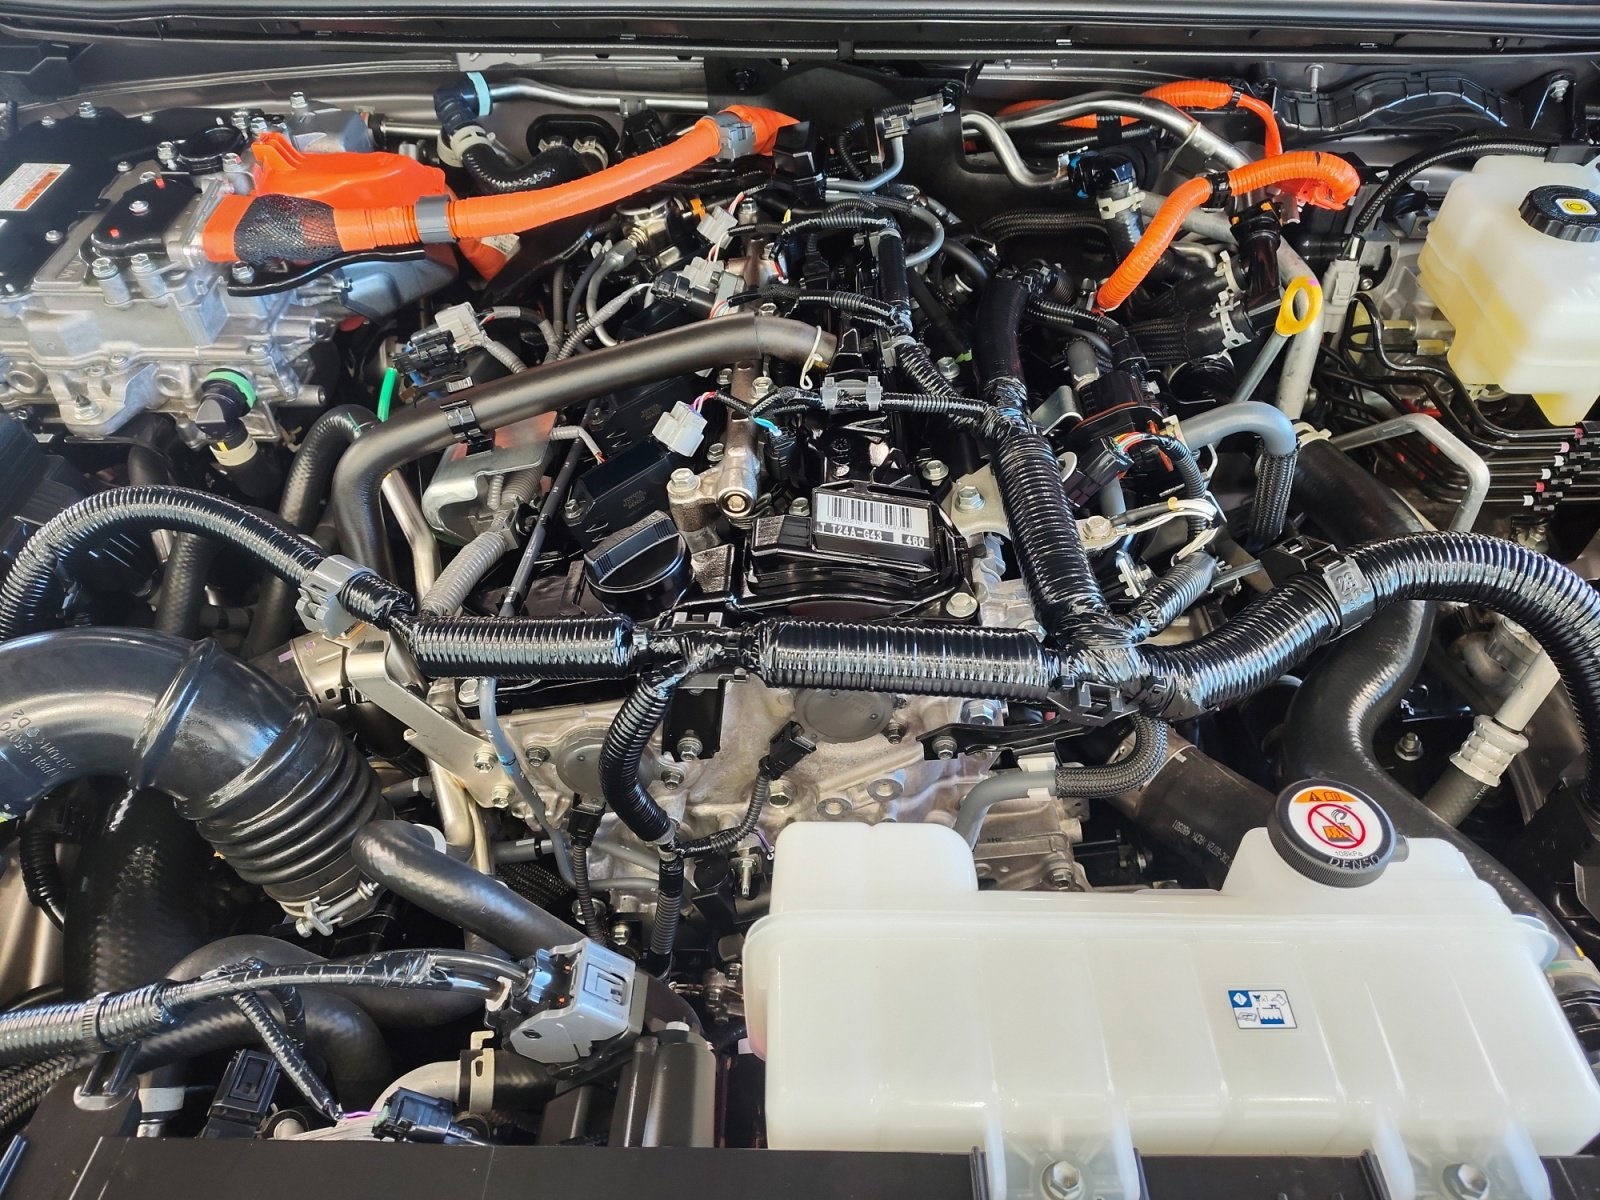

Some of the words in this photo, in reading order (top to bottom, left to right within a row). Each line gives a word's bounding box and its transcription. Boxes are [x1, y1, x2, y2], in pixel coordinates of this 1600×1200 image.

[820, 523, 826, 533] T
[832, 525, 882, 542] T24A-G43
[1329, 854, 1380, 870] DENSO
